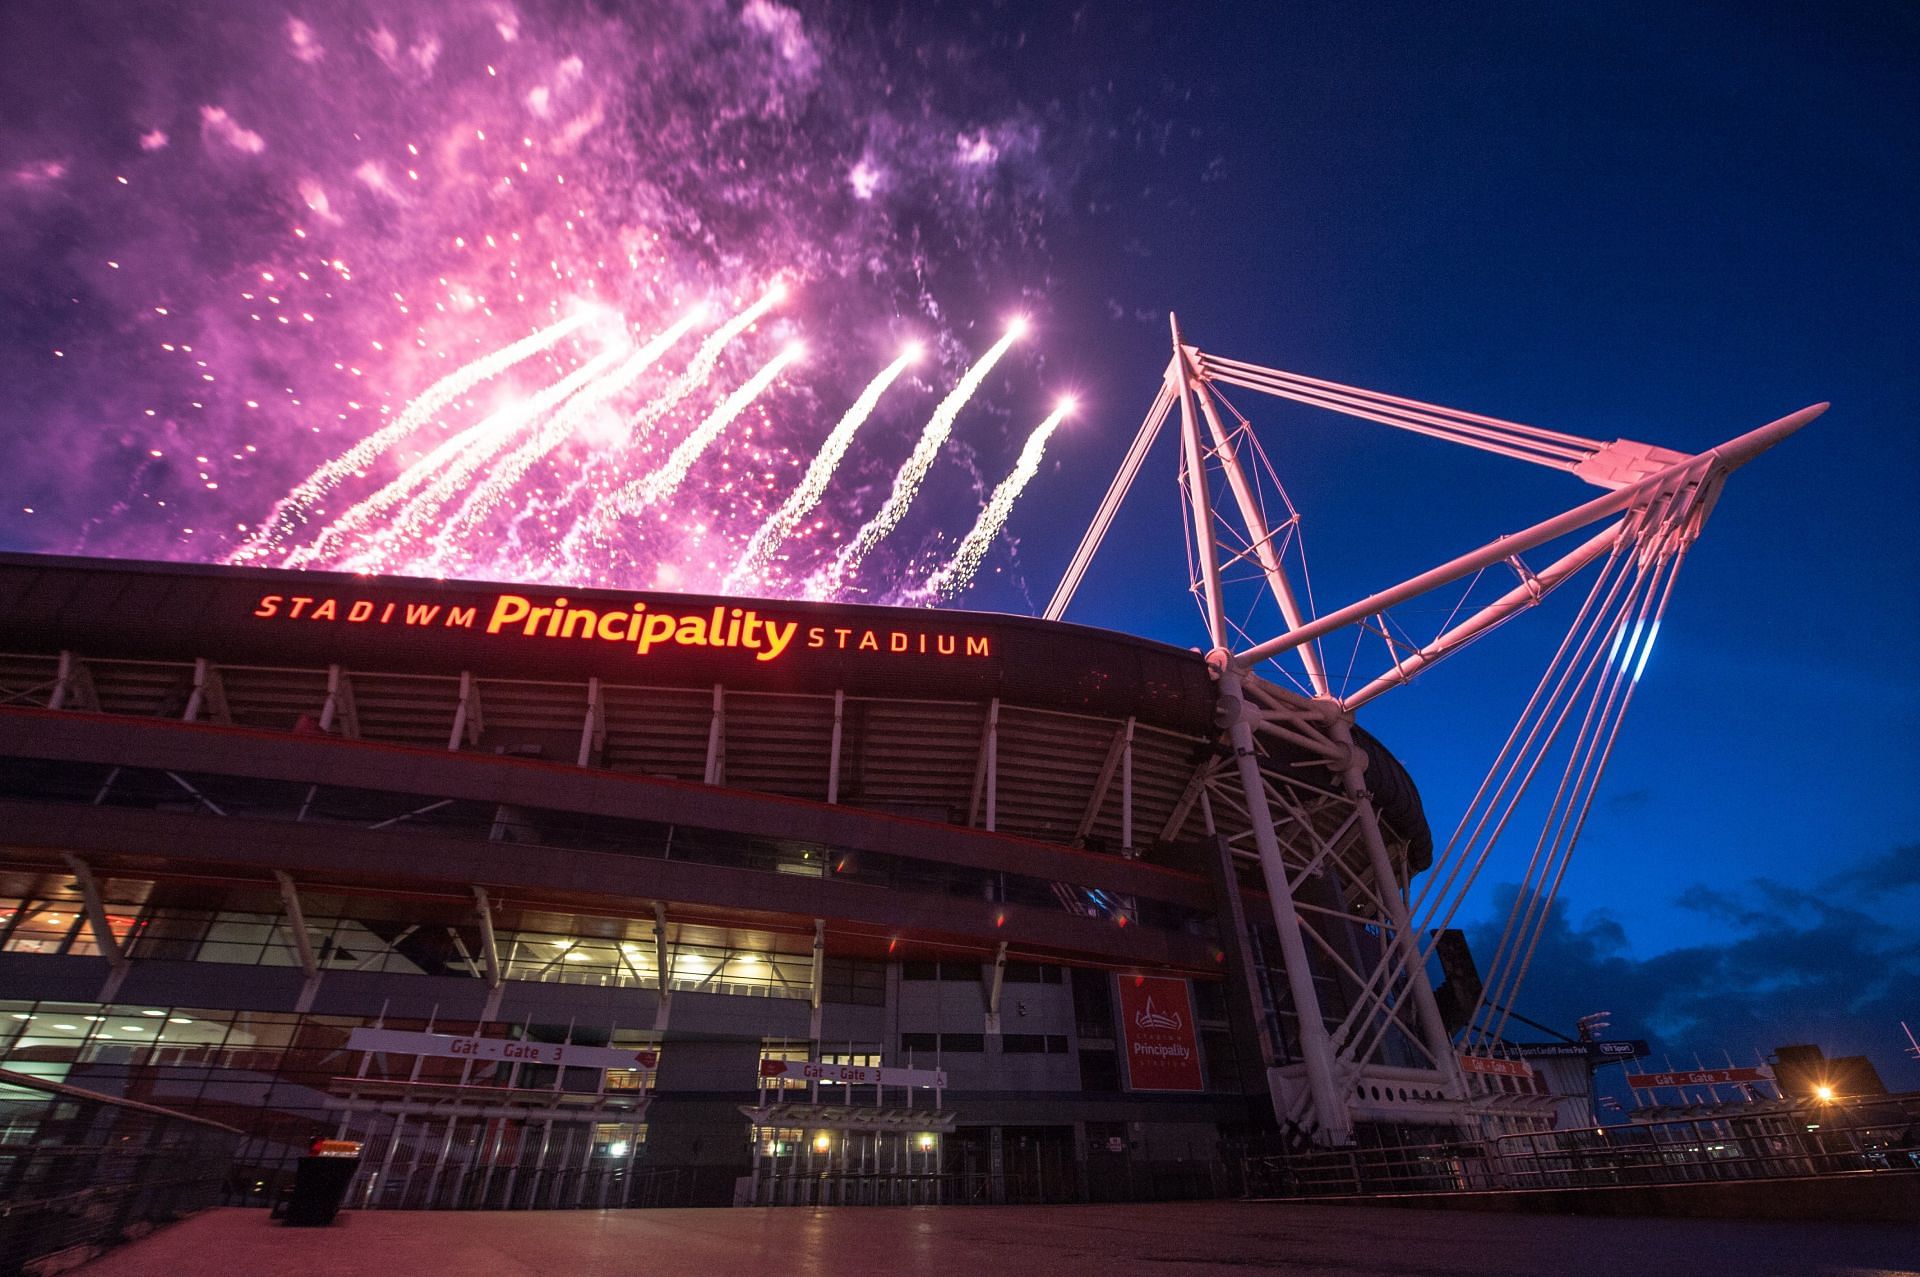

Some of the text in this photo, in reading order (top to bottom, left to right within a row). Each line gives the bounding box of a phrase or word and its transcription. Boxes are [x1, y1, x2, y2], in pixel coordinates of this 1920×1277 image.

[254, 594, 989, 661] STADIWM Principality STADIUM
[504, 1043, 539, 1060] Gate
[553, 1047, 562, 1060] 3
[1134, 1043, 1190, 1060] Principality
[1573, 1045, 1588, 1054] Park
[840, 1067, 865, 1081] Gate
[876, 1069, 882, 1082] 3
[1688, 1071, 1715, 1083] Gate
[1722, 1071, 1731, 1081] 2
